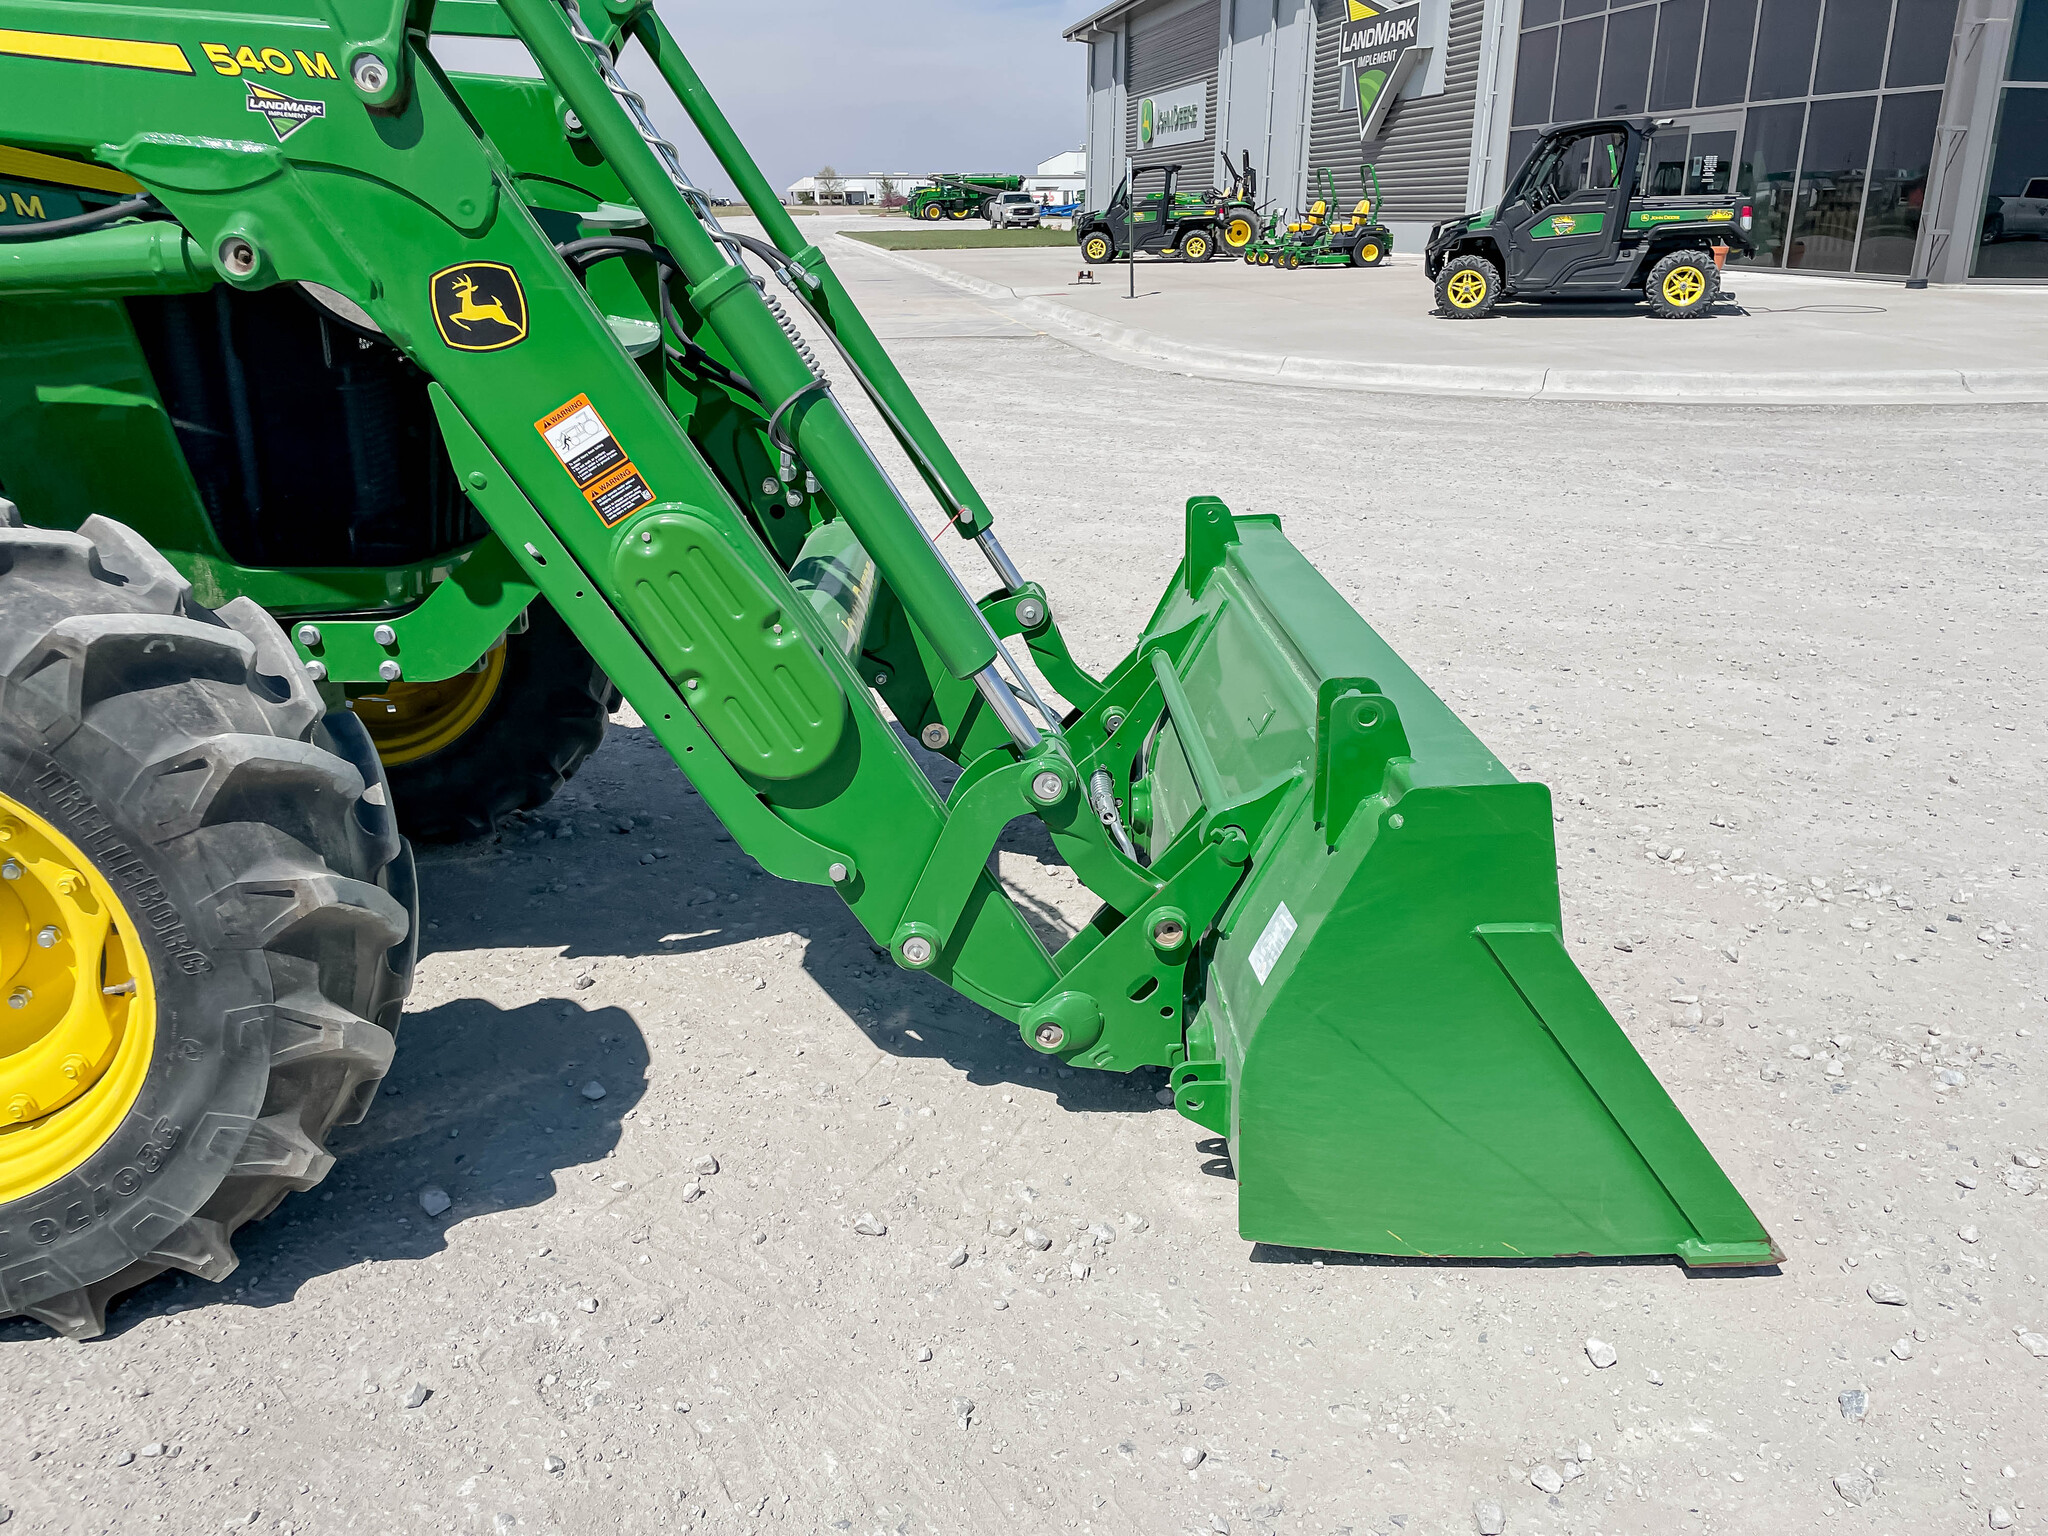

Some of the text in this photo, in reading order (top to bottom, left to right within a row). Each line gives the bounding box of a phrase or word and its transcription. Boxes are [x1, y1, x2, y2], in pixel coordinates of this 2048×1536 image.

[199, 42, 341, 80] 540 M
[1357, 49, 1398, 68] IMPLEMENT
[268, 110, 308, 119] IMPLEMENT
[549, 399, 583, 424] WARNING
[598, 468, 632, 492] WARNING
[33, 760, 214, 976] TRELLEBORG
